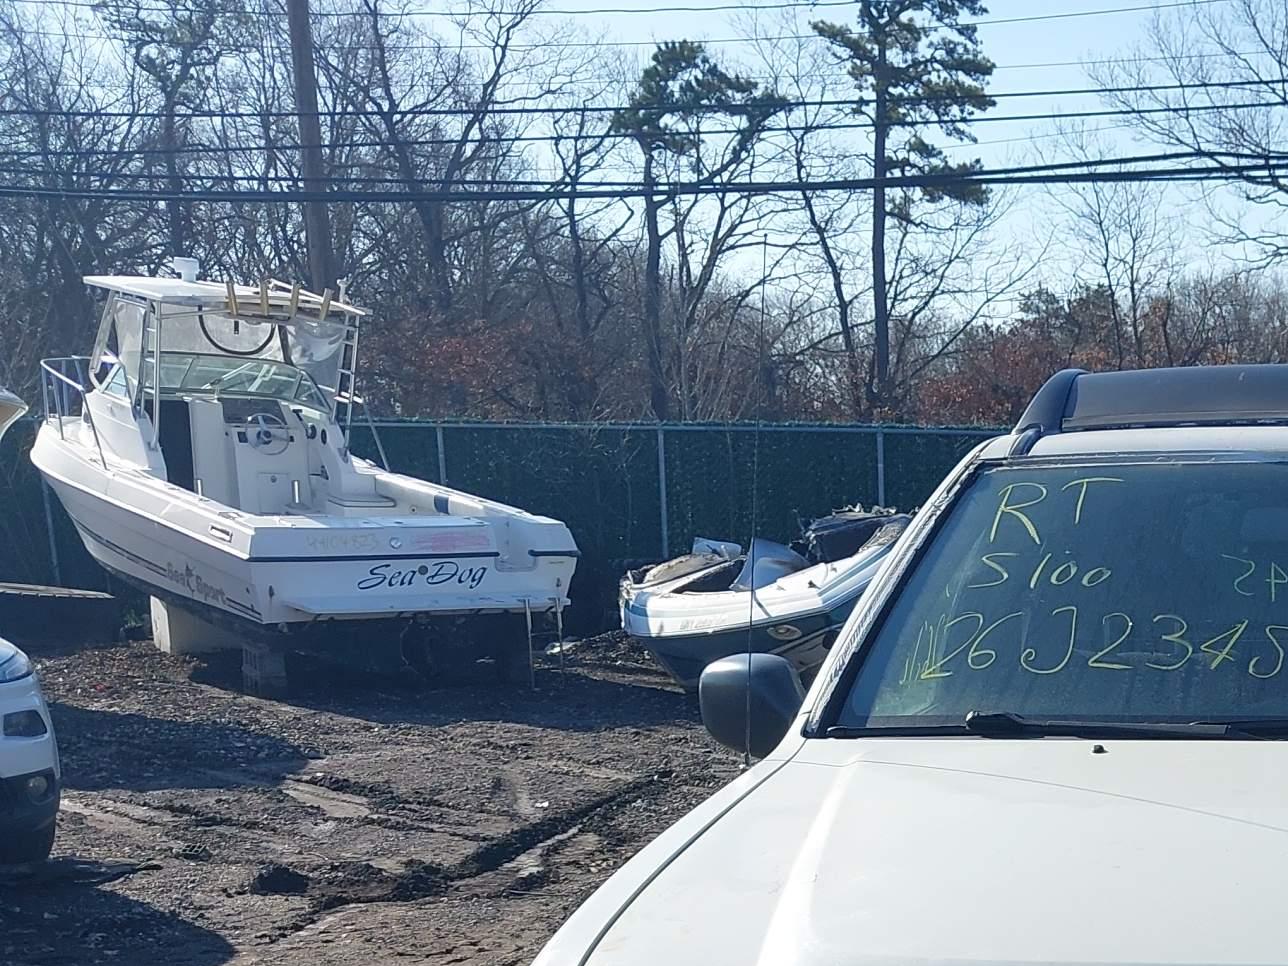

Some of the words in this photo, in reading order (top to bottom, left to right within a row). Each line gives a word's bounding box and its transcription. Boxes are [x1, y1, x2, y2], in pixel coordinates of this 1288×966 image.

[987, 476, 1126, 545] RT
[357, 563, 418, 590] Sea
[426, 561, 488, 589] Dog
[967, 552, 1112, 590] S100
